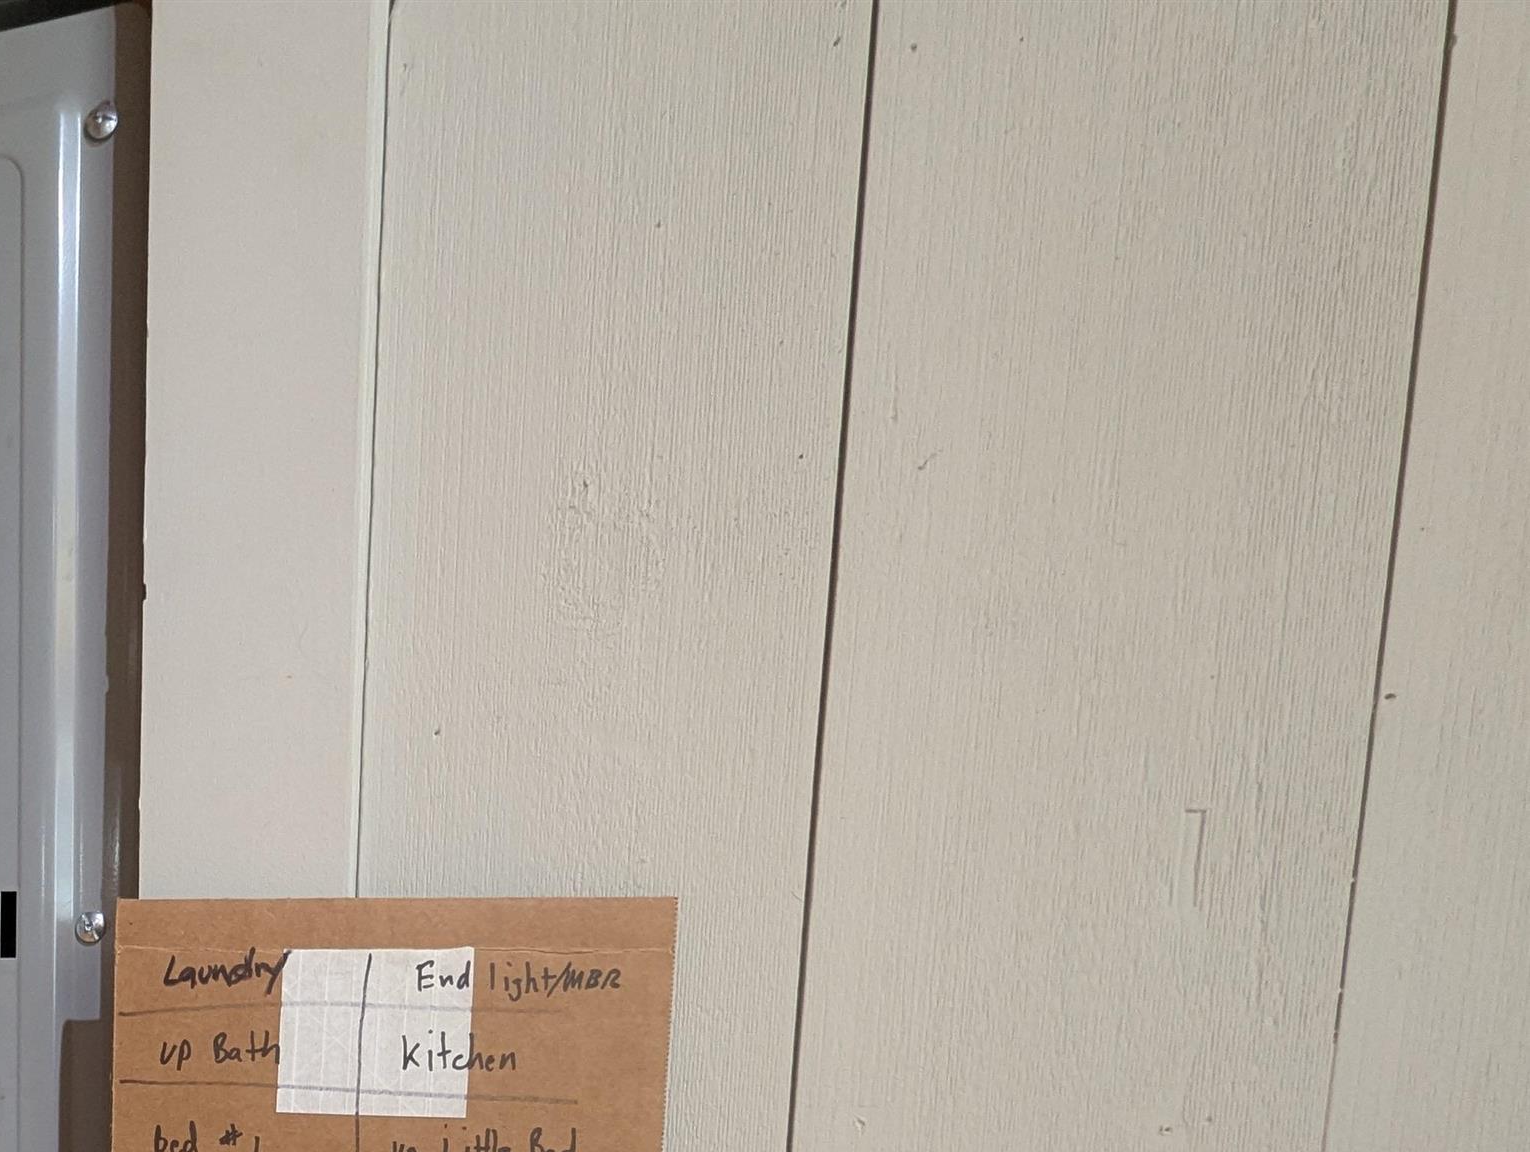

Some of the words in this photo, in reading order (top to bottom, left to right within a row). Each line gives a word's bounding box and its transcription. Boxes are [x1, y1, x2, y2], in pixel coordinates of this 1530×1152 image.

[164, 947, 292, 995] Laundry
[416, 960, 471, 992] End
[213, 1030, 281, 1065] Bath
